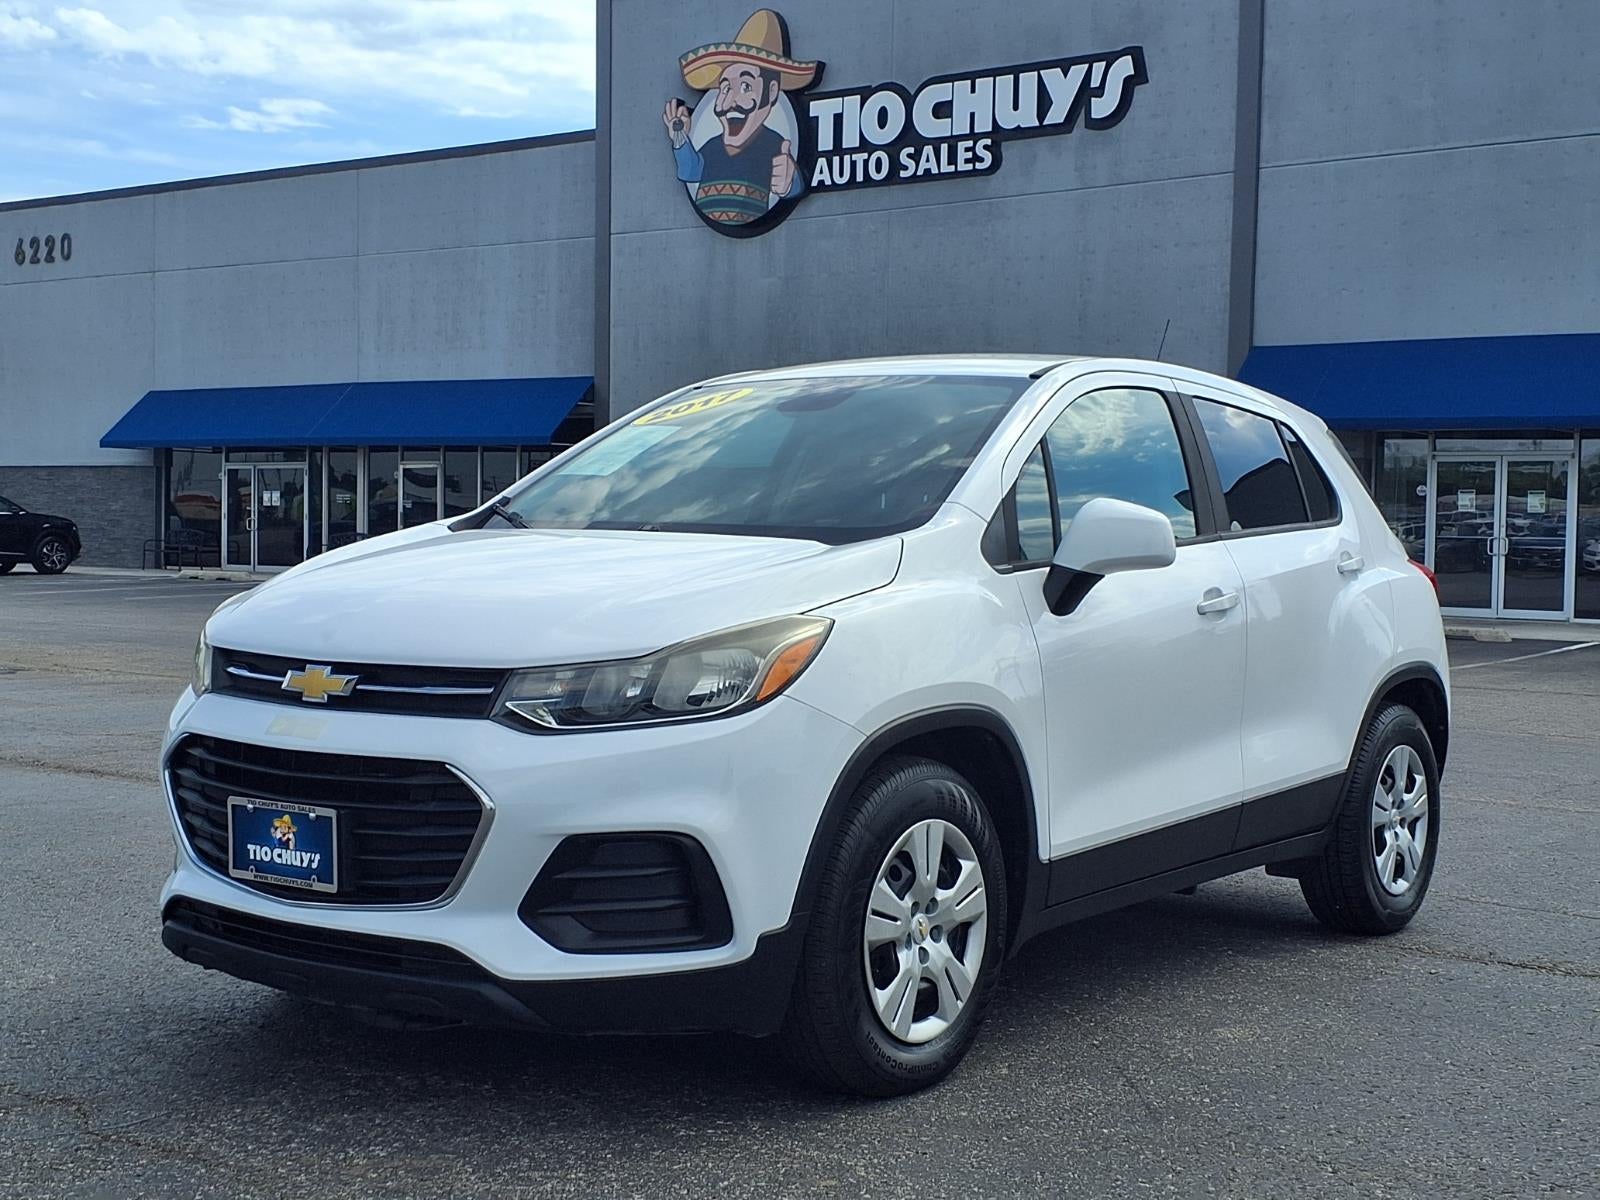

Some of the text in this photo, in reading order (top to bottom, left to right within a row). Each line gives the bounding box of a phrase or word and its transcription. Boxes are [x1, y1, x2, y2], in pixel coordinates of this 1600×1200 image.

[809, 55, 1134, 151] TIO CHUY'S
[811, 138, 992, 187] AUTO SALES
[14, 233, 72, 266] 6220
[247, 843, 321, 869] TIO CHUY'S
